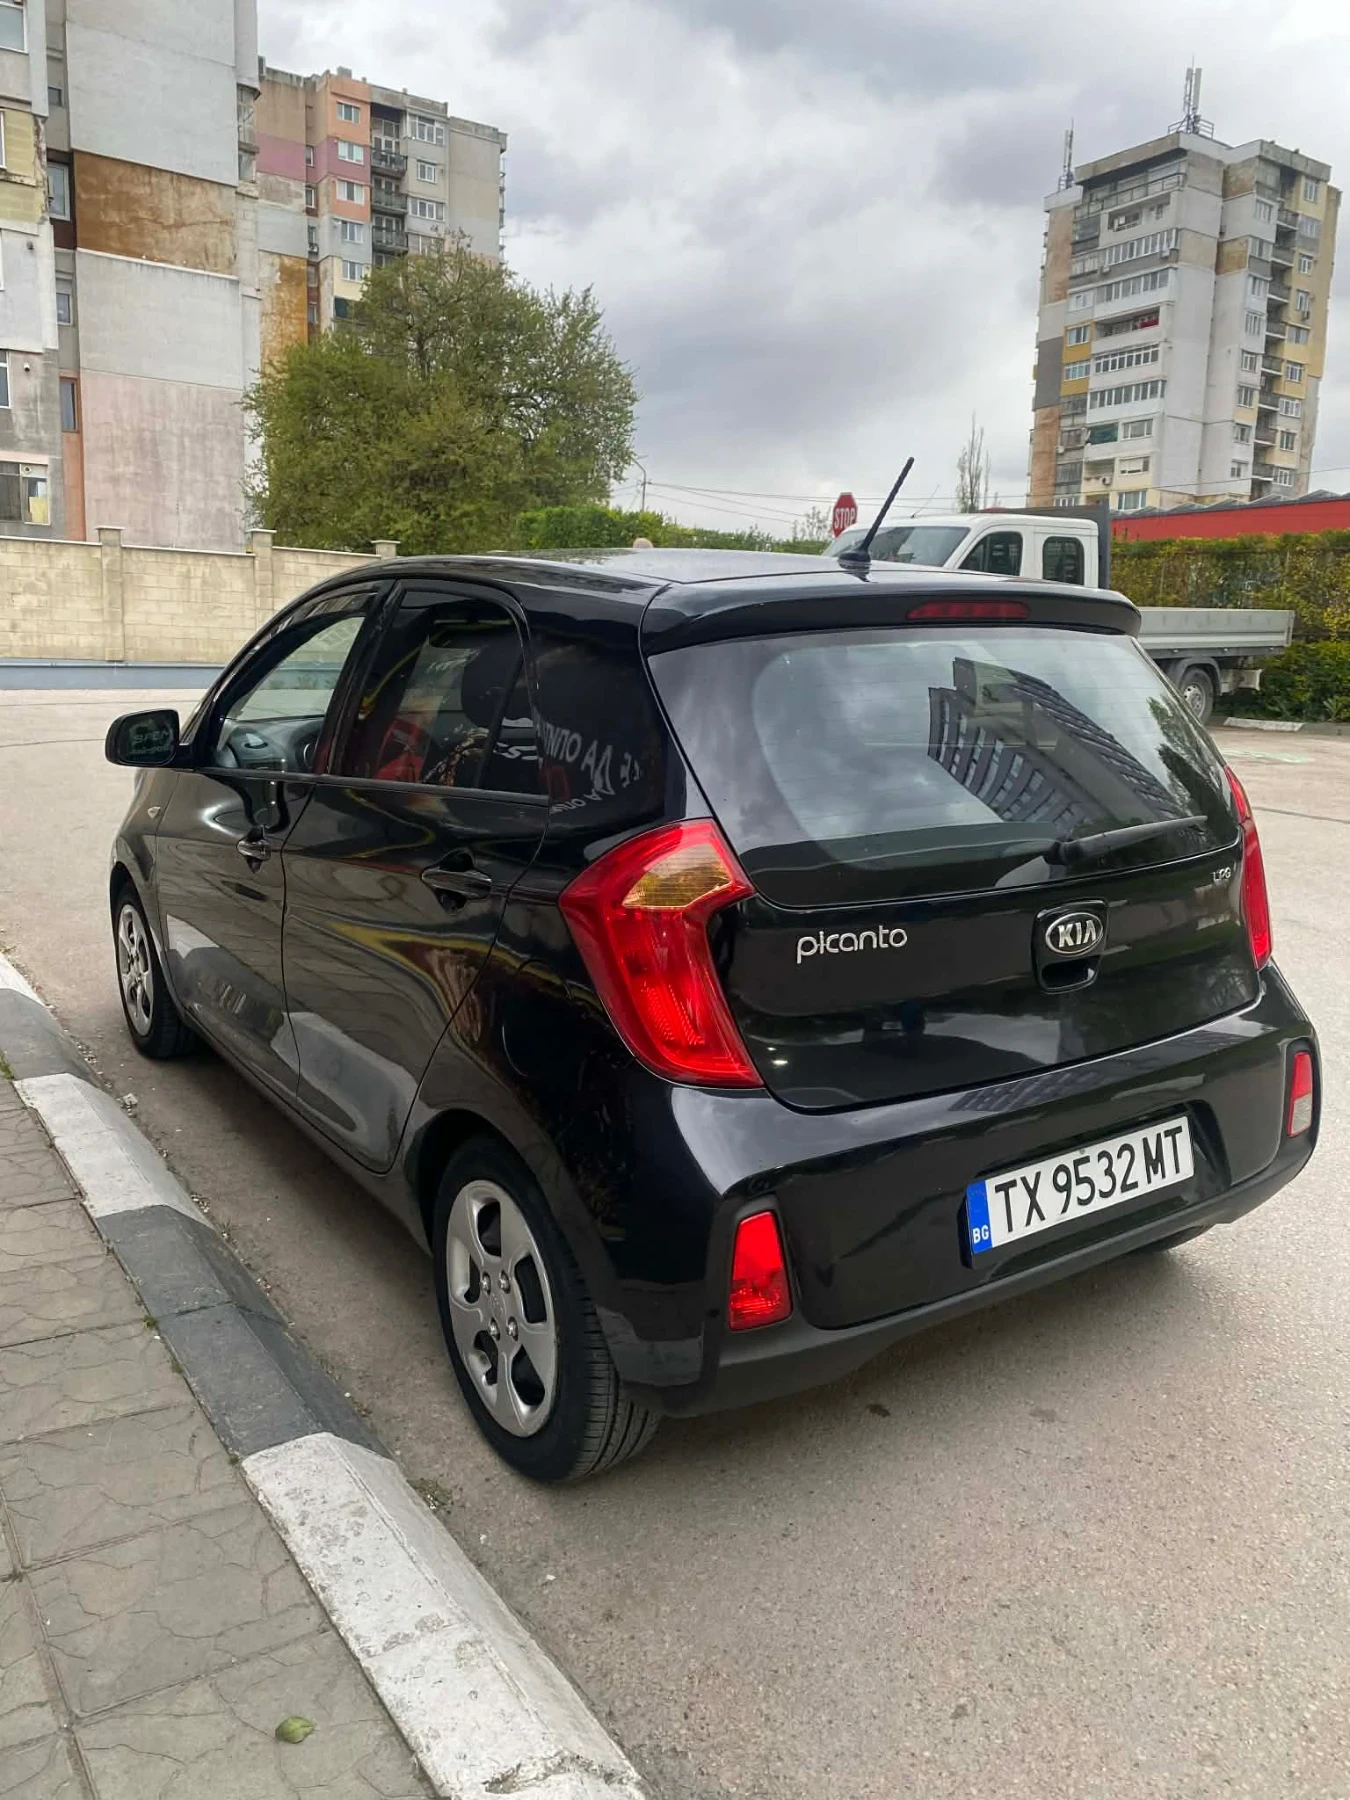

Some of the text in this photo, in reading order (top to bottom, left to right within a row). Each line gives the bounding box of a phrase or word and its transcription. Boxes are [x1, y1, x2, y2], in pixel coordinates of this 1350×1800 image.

[834, 507, 856, 530] STOP
[796, 925, 908, 964] picanto
[1057, 919, 1097, 948] KIA
[994, 1125, 1183, 1233] TX 9532 MT
[971, 1224, 990, 1244] BG
